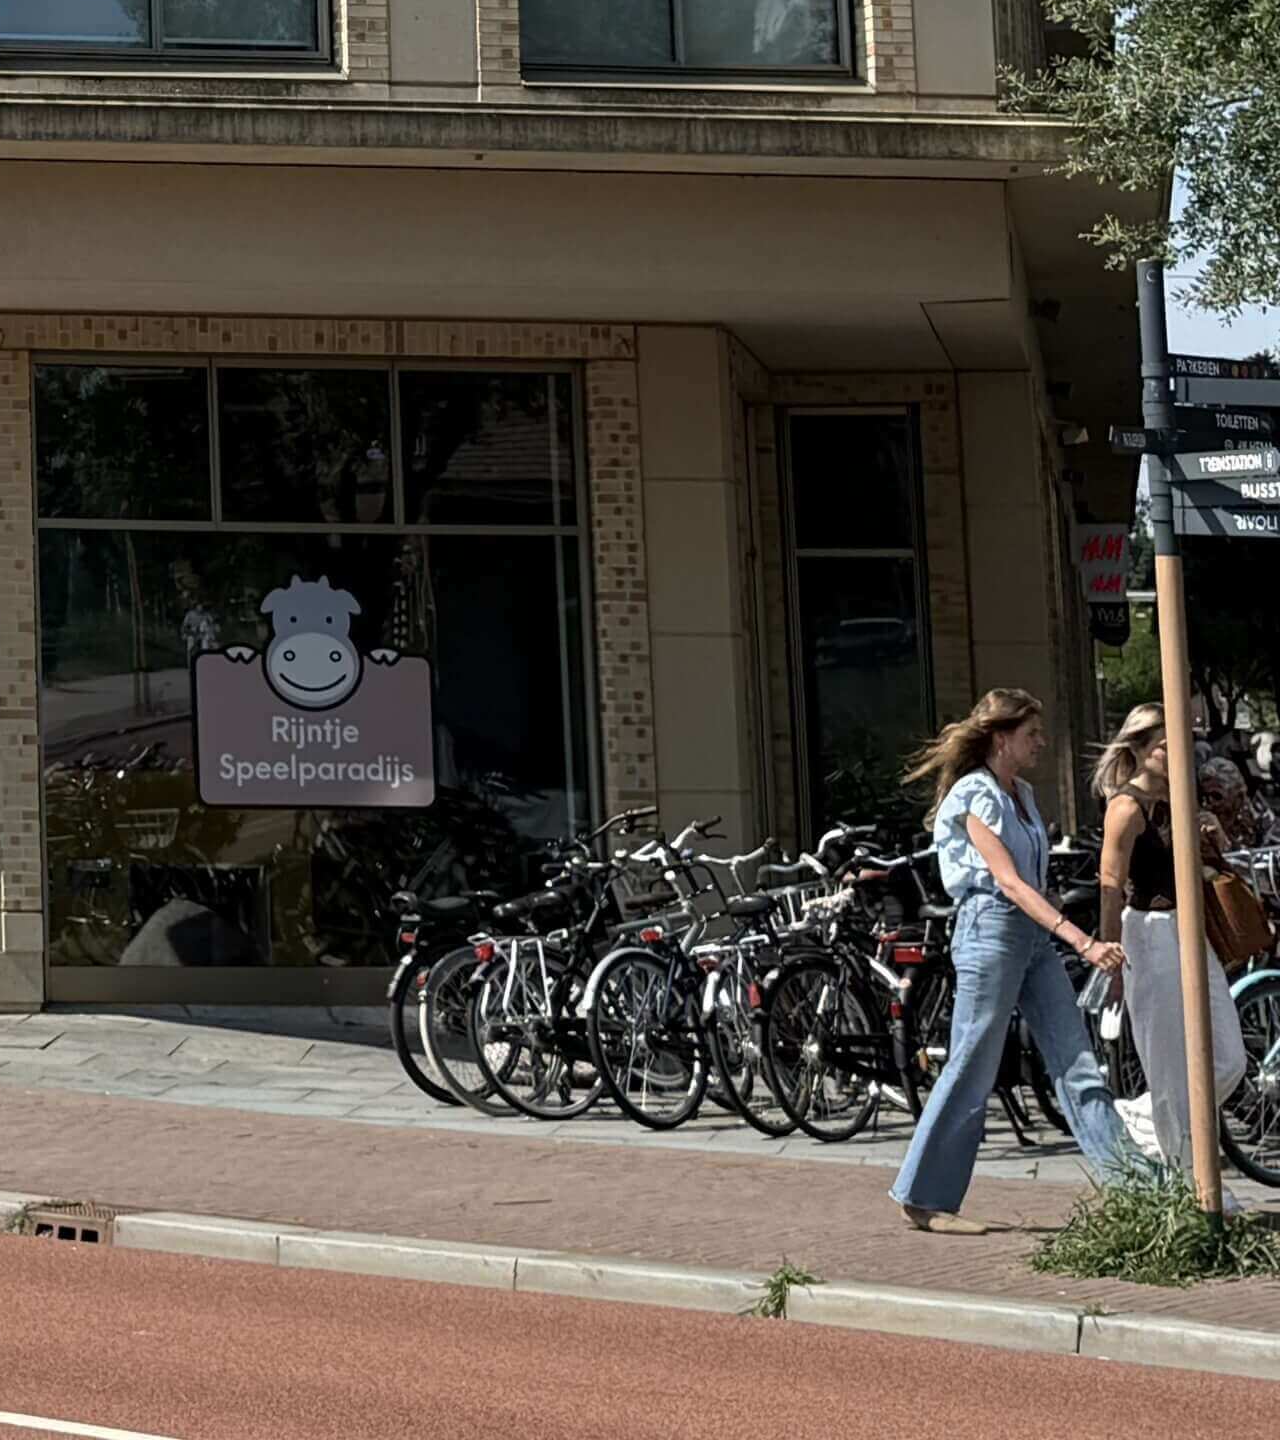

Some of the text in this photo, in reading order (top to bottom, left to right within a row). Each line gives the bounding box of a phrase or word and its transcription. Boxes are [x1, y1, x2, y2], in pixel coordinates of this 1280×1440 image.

[1176, 357, 1220, 376] PARKEREN
[1215, 413, 1259, 431] TOILETTEN
[271, 715, 360, 749] Rijntje
[219, 752, 415, 788] Speelparadijs
